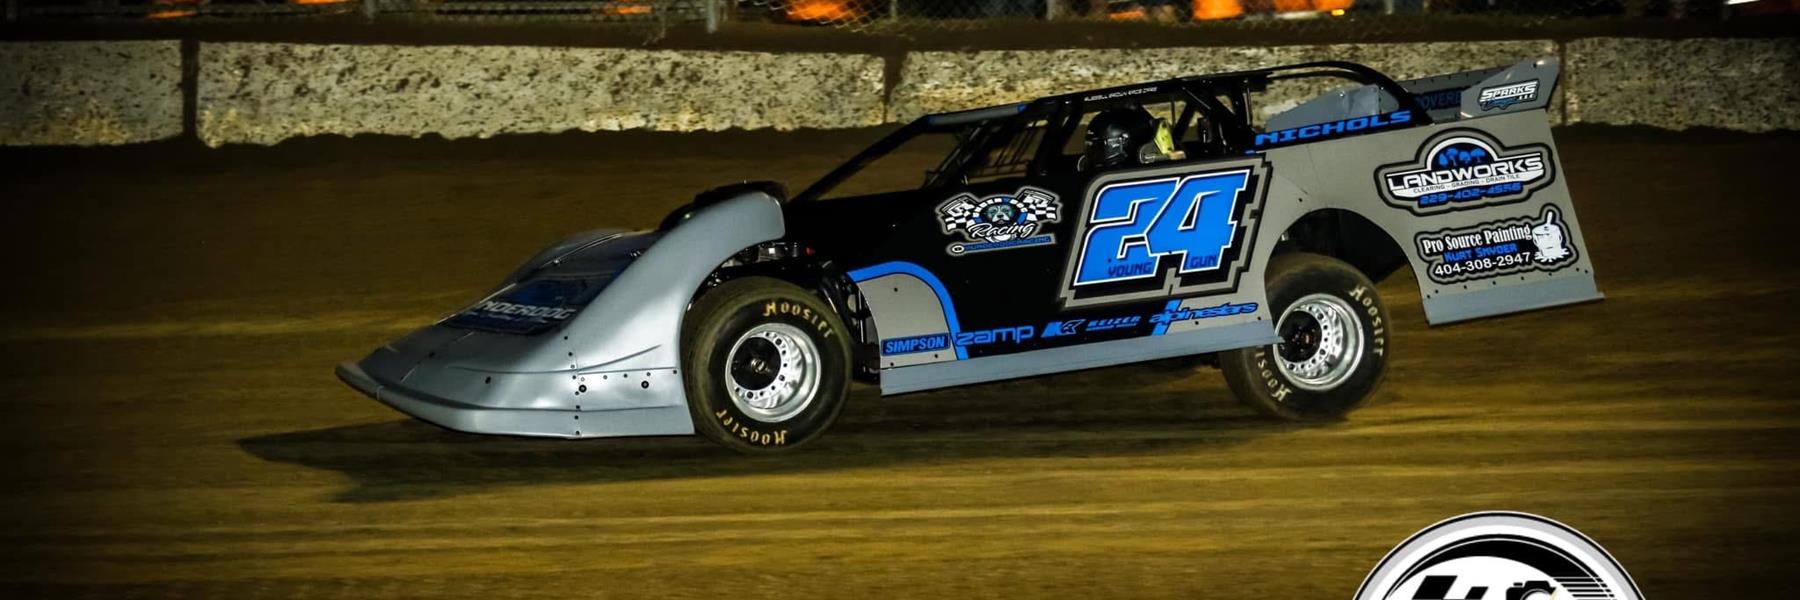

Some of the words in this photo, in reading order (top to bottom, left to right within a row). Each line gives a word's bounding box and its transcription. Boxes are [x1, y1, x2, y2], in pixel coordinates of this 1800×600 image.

[1481, 80, 1538, 101] SPARKS
[1254, 109, 1412, 146] NICHOLS
[1387, 156, 1544, 191] LANDWORKS
[1413, 184, 1446, 194] CLEARING
[1451, 179, 1480, 189] GRADING
[1485, 175, 1506, 184] DRAIN
[1506, 173, 1520, 181] TILE
[968, 222, 1036, 239] Racing
[1073, 169, 1250, 286] 24
[1422, 238, 1444, 254] Pro
[1447, 232, 1483, 251] Source
[1483, 224, 1533, 246] Painting
[1107, 261, 1152, 277] YOUNG
[1190, 255, 1217, 269] GUN
[1434, 251, 1531, 277] 404-308-2947
[479, 301, 577, 320] NDERDOG
[884, 334, 946, 354] SIMPSON
[957, 324, 1034, 346] zamp
